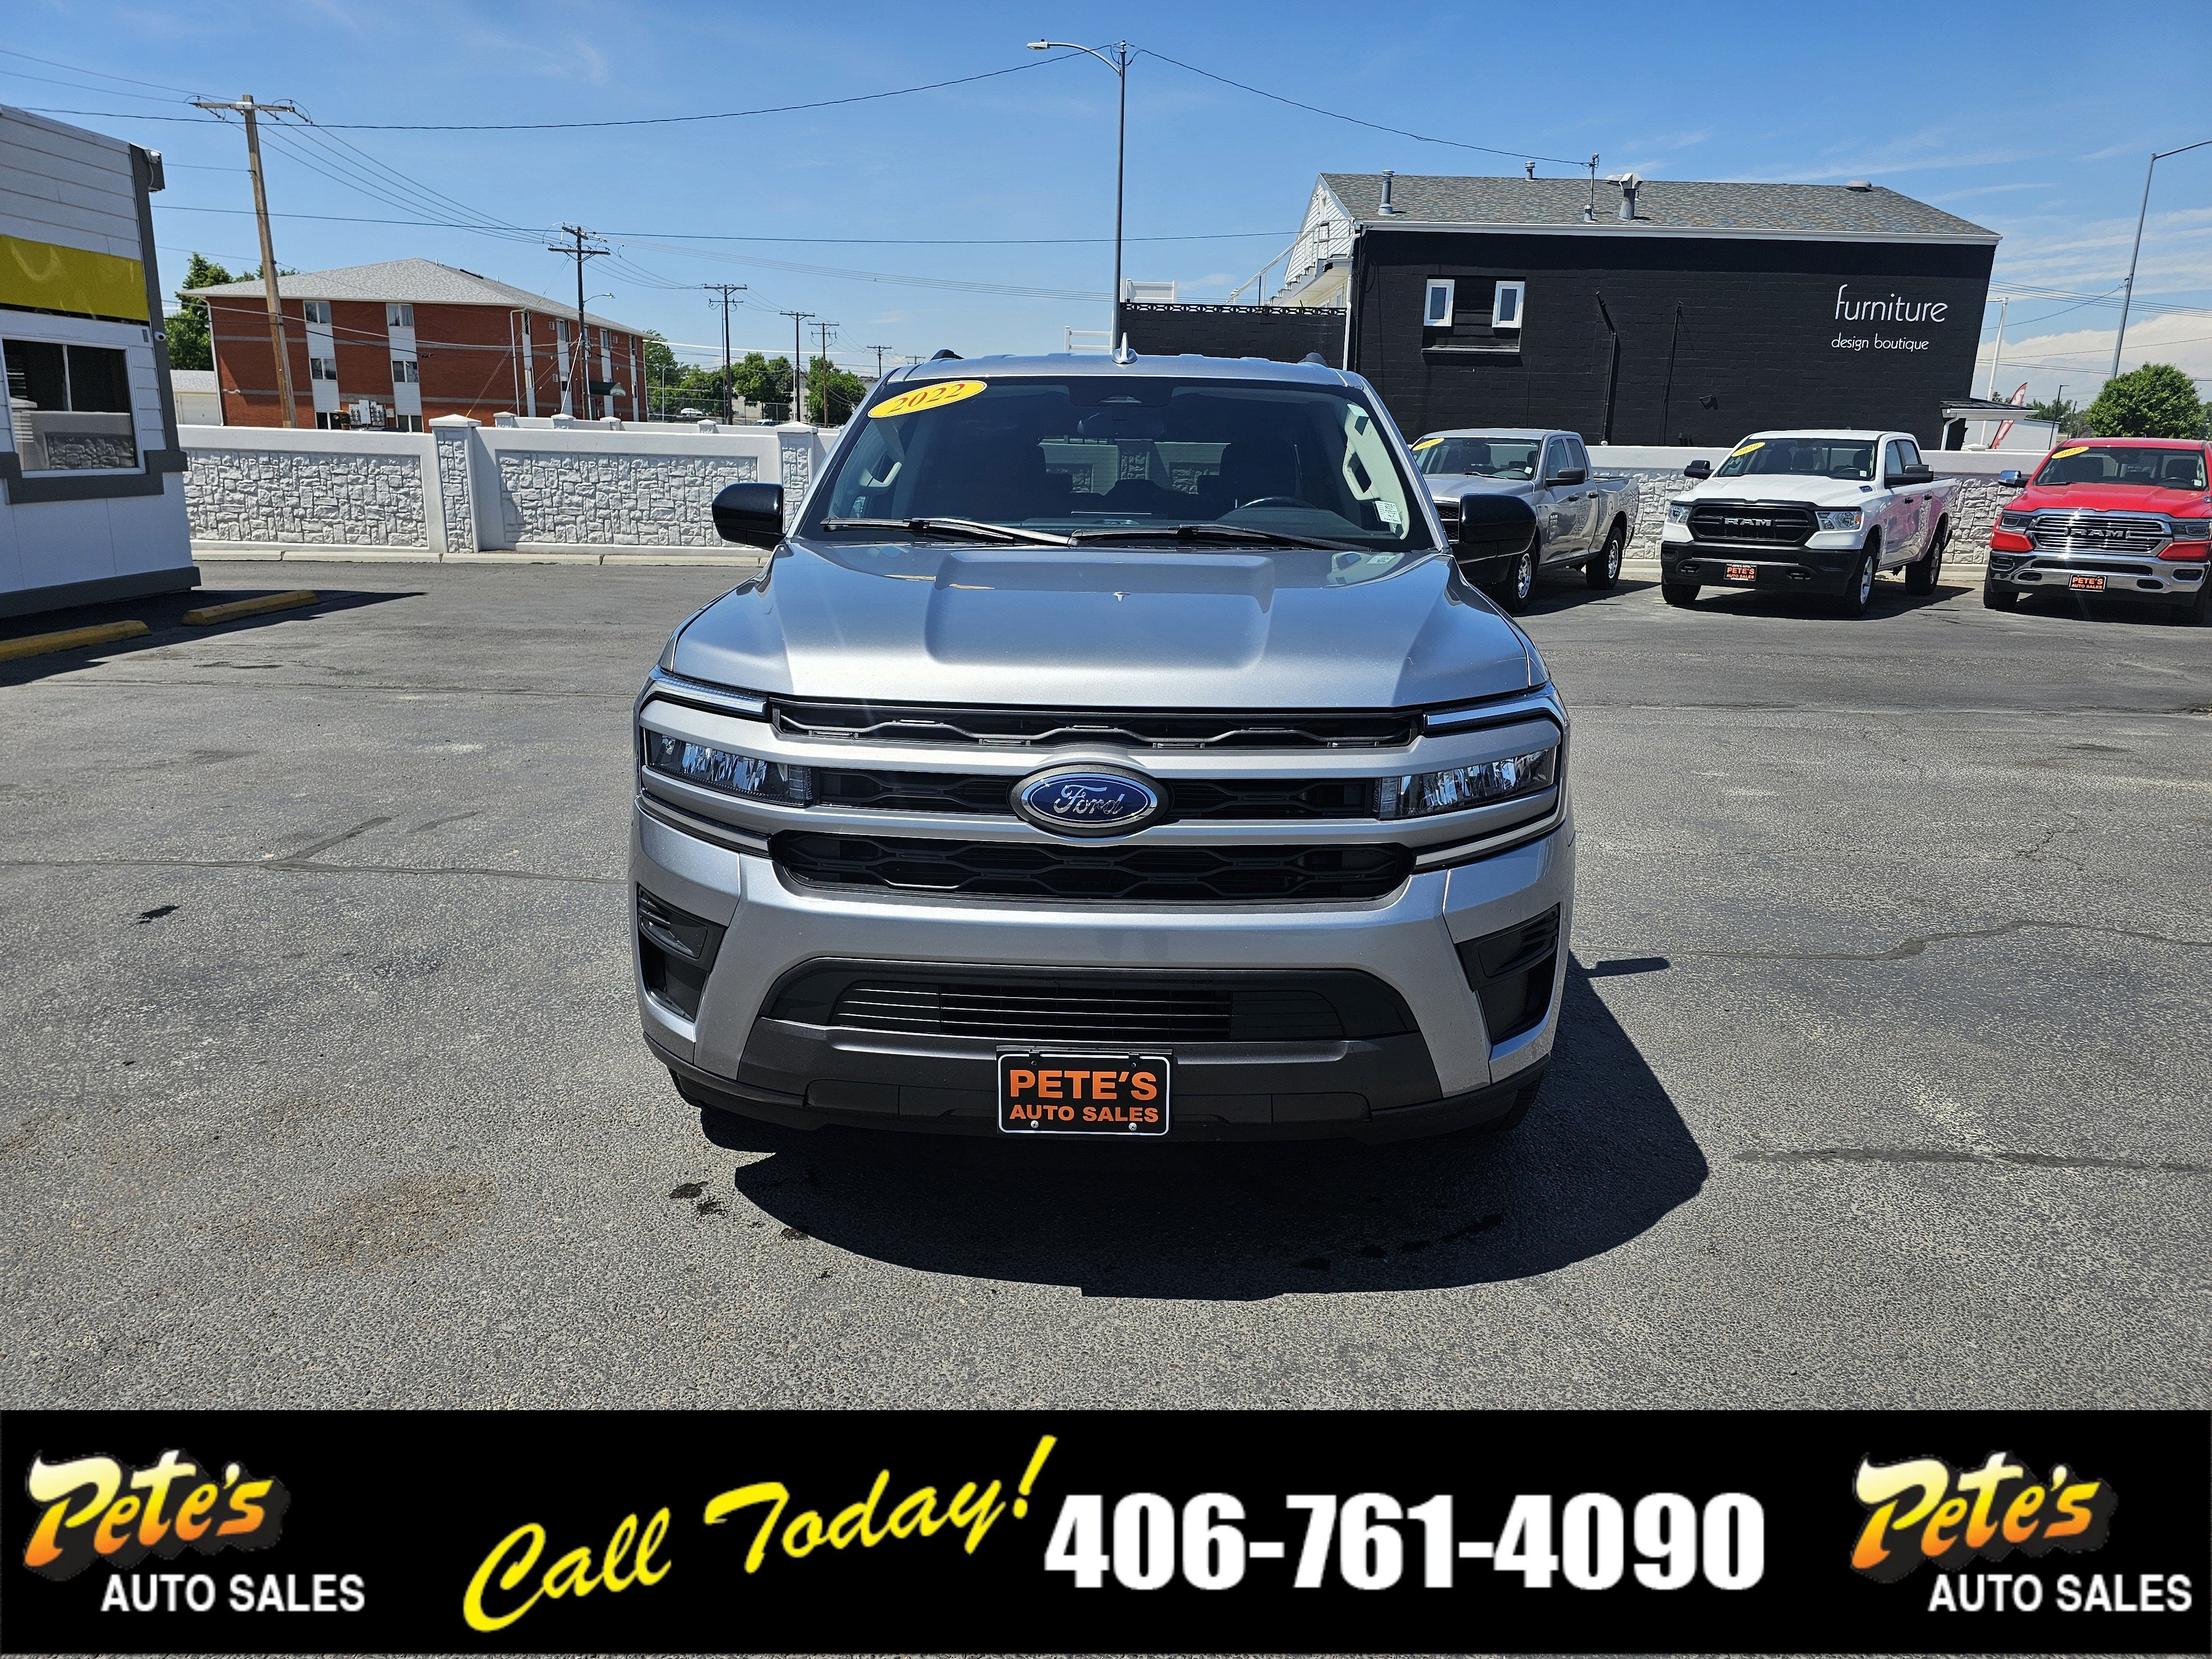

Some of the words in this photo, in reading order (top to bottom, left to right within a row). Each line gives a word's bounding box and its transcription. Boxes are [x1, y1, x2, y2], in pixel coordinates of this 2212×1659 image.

[1835, 284, 1948, 322] furniture
[1831, 332, 1869, 351] design
[1874, 333, 1929, 352] boutique
[886, 383, 965, 414] 2022
[1724, 518, 1771, 526] RAM
[2070, 529, 2124, 537] RAM
[2072, 577, 2103, 585] PETE'S
[1053, 784, 1125, 815] Ford
[1010, 1069, 1157, 1100] PETE'S
[1009, 1104, 1074, 1120] AUTO
[1082, 1107, 1159, 1123] SALES
